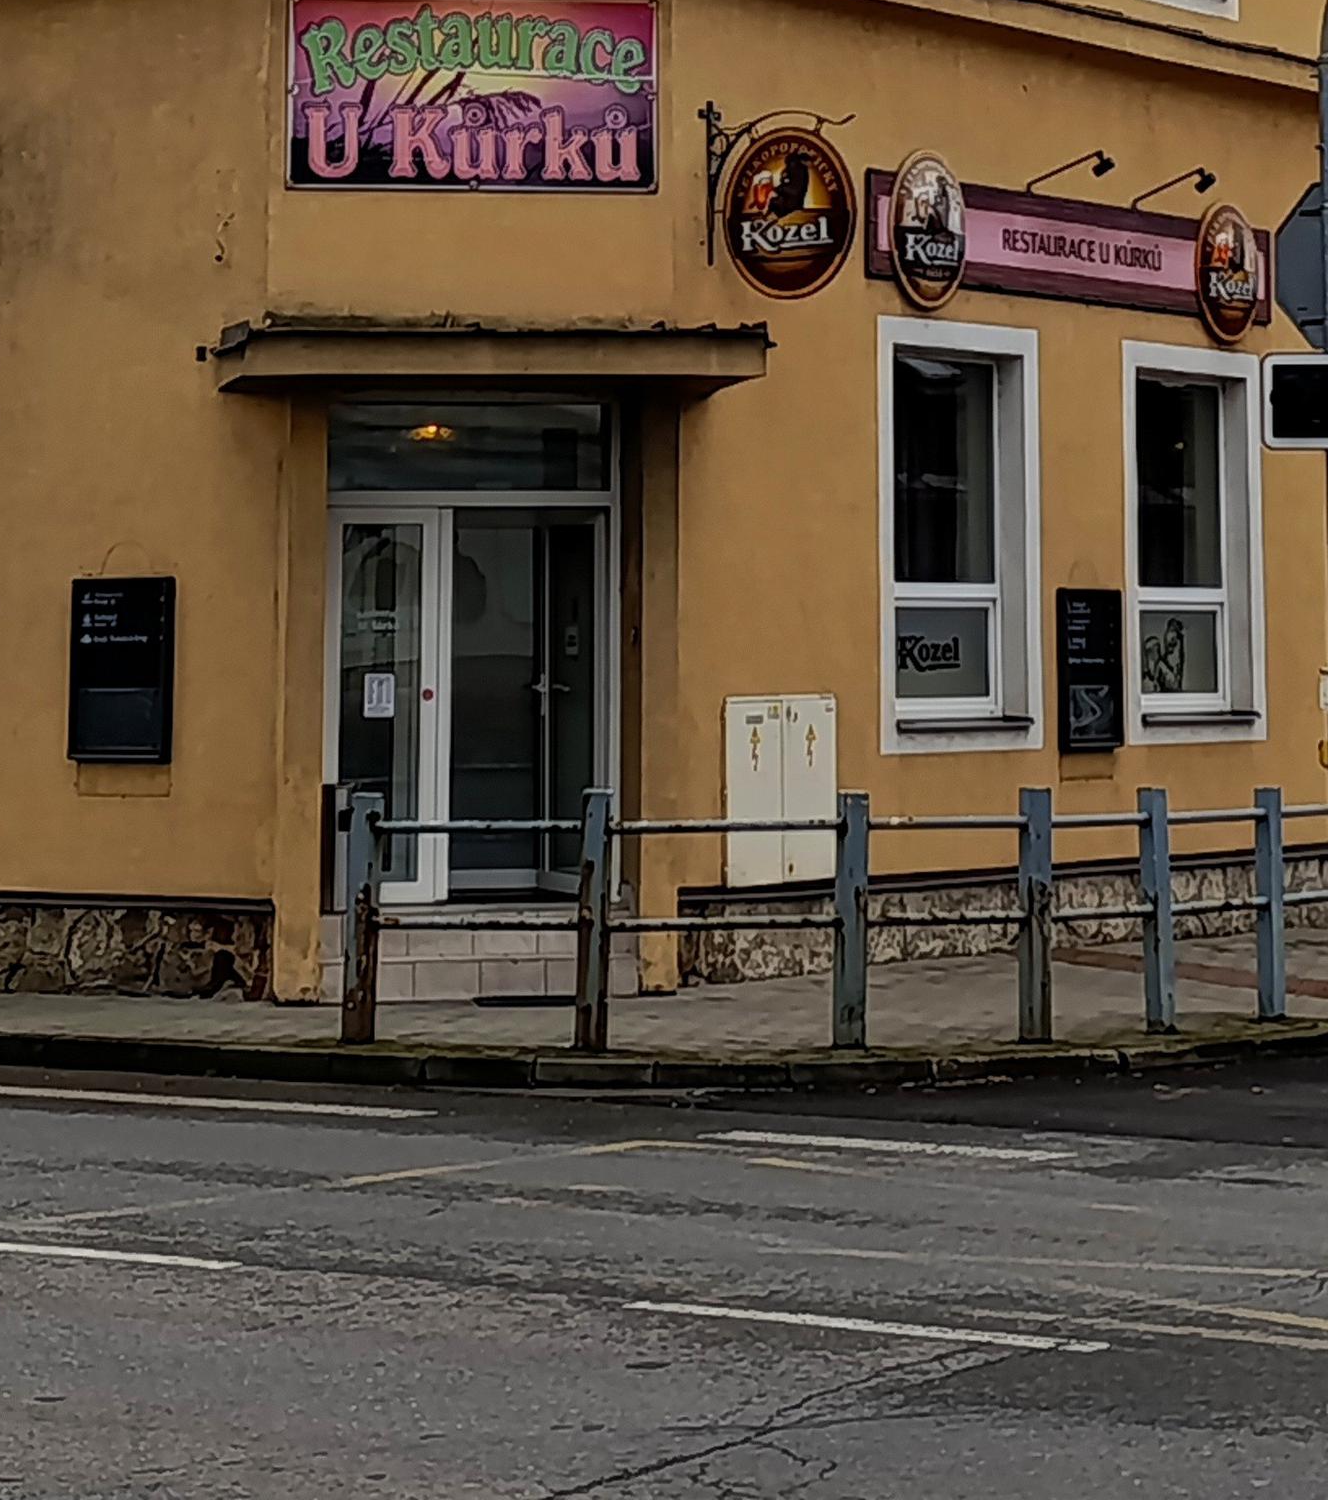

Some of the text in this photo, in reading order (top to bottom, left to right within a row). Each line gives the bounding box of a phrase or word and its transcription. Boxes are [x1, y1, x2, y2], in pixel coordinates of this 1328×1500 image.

[302, 3, 646, 95] Restaurace
[304, 102, 640, 181] U Kůrků
[740, 216, 834, 252] Kozel
[904, 233, 959, 265] Kozel
[1002, 228, 1162, 271] RESTAURACE U KŮRKŮ
[1209, 271, 1254, 301] Kozel
[898, 635, 961, 673] Kozel
